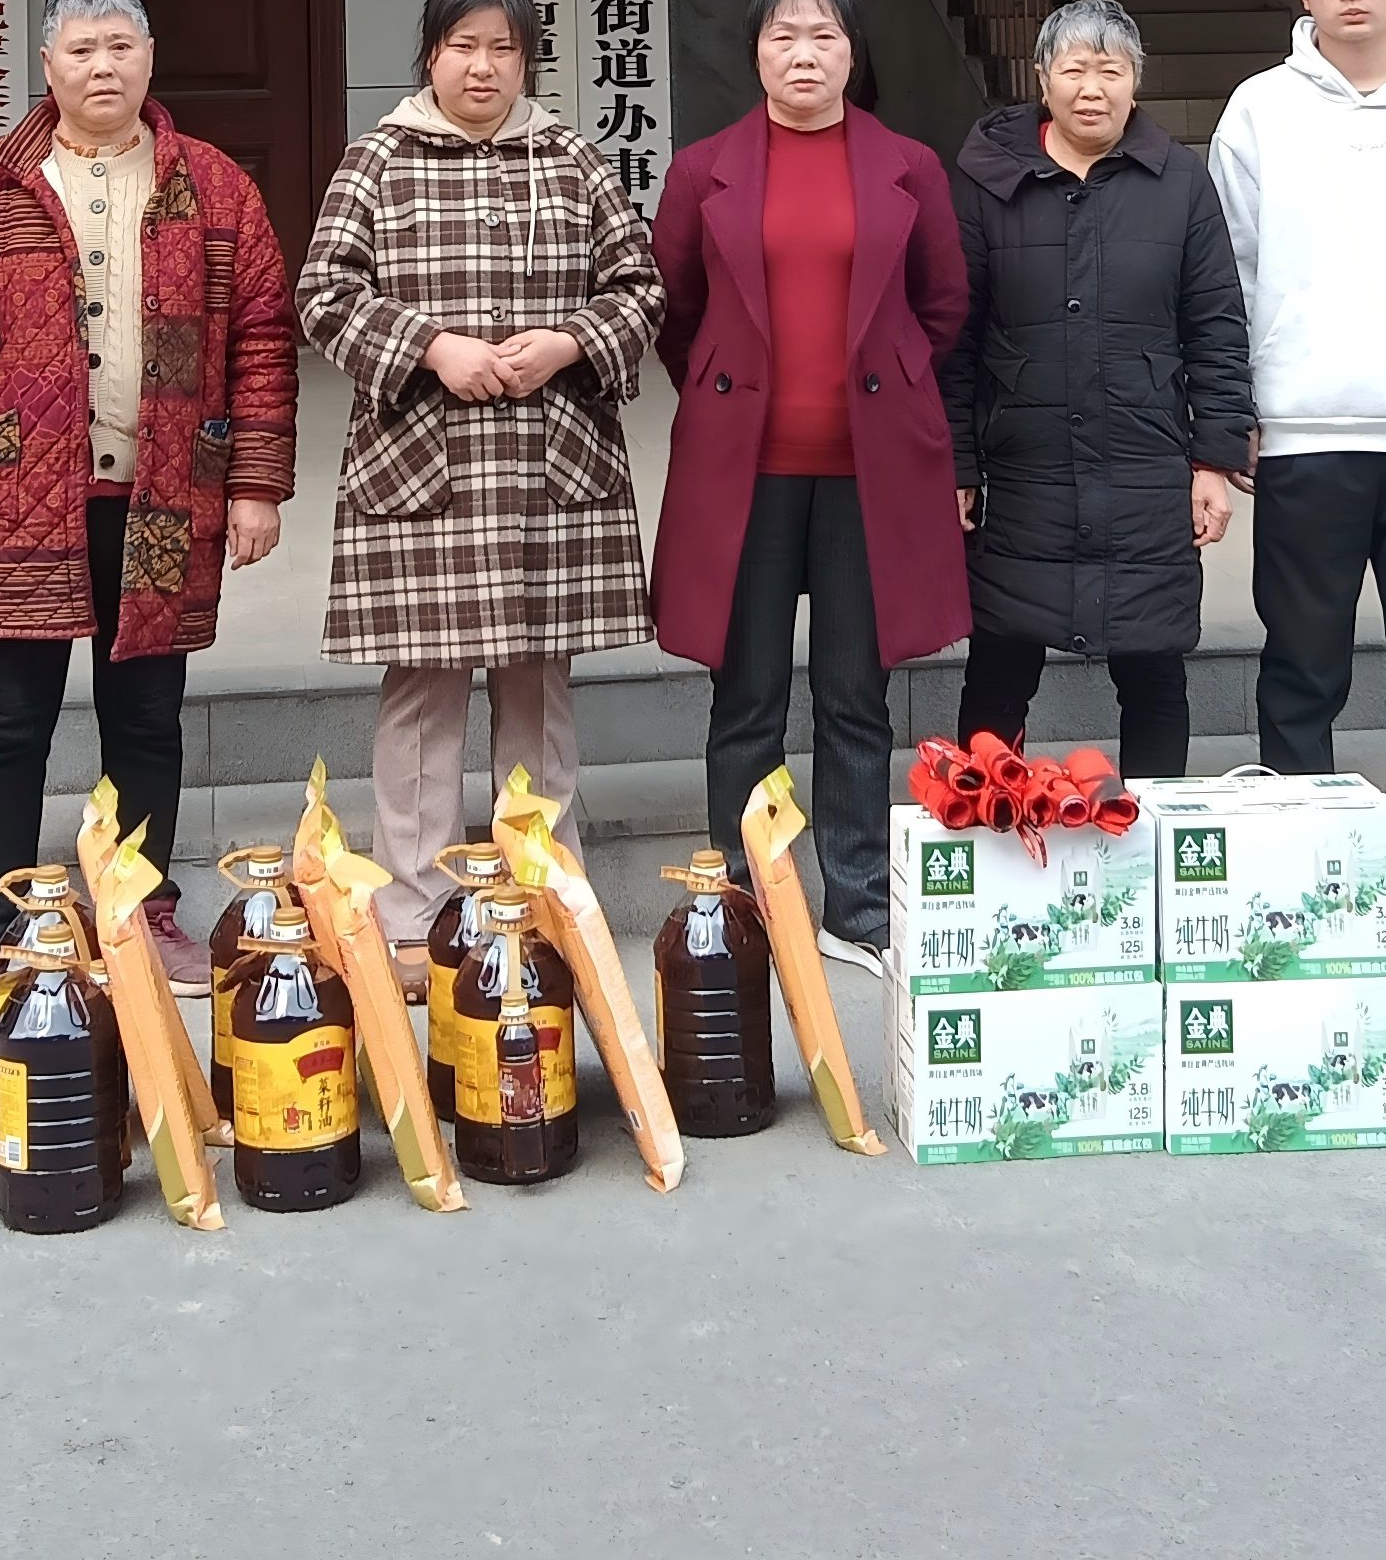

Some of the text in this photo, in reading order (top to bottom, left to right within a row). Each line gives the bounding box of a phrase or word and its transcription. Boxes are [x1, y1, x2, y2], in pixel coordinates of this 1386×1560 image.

[926, 847, 970, 881] 金典
[1178, 833, 1222, 867] 金典
[926, 880, 969, 890] SATINE
[1179, 866, 1222, 877] SATINE
[921, 928, 974, 968] 纯牛奶
[1175, 915, 1229, 955] 纯牛奶
[932, 1015, 976, 1049] 金典
[1185, 1005, 1229, 1039] 金典
[933, 1048, 977, 1059] SATINE
[1186, 1039, 1229, 1049] SATINE
[928, 1097, 982, 1137] 纯牛奶
[1181, 1087, 1235, 1127] 纯牛奶
